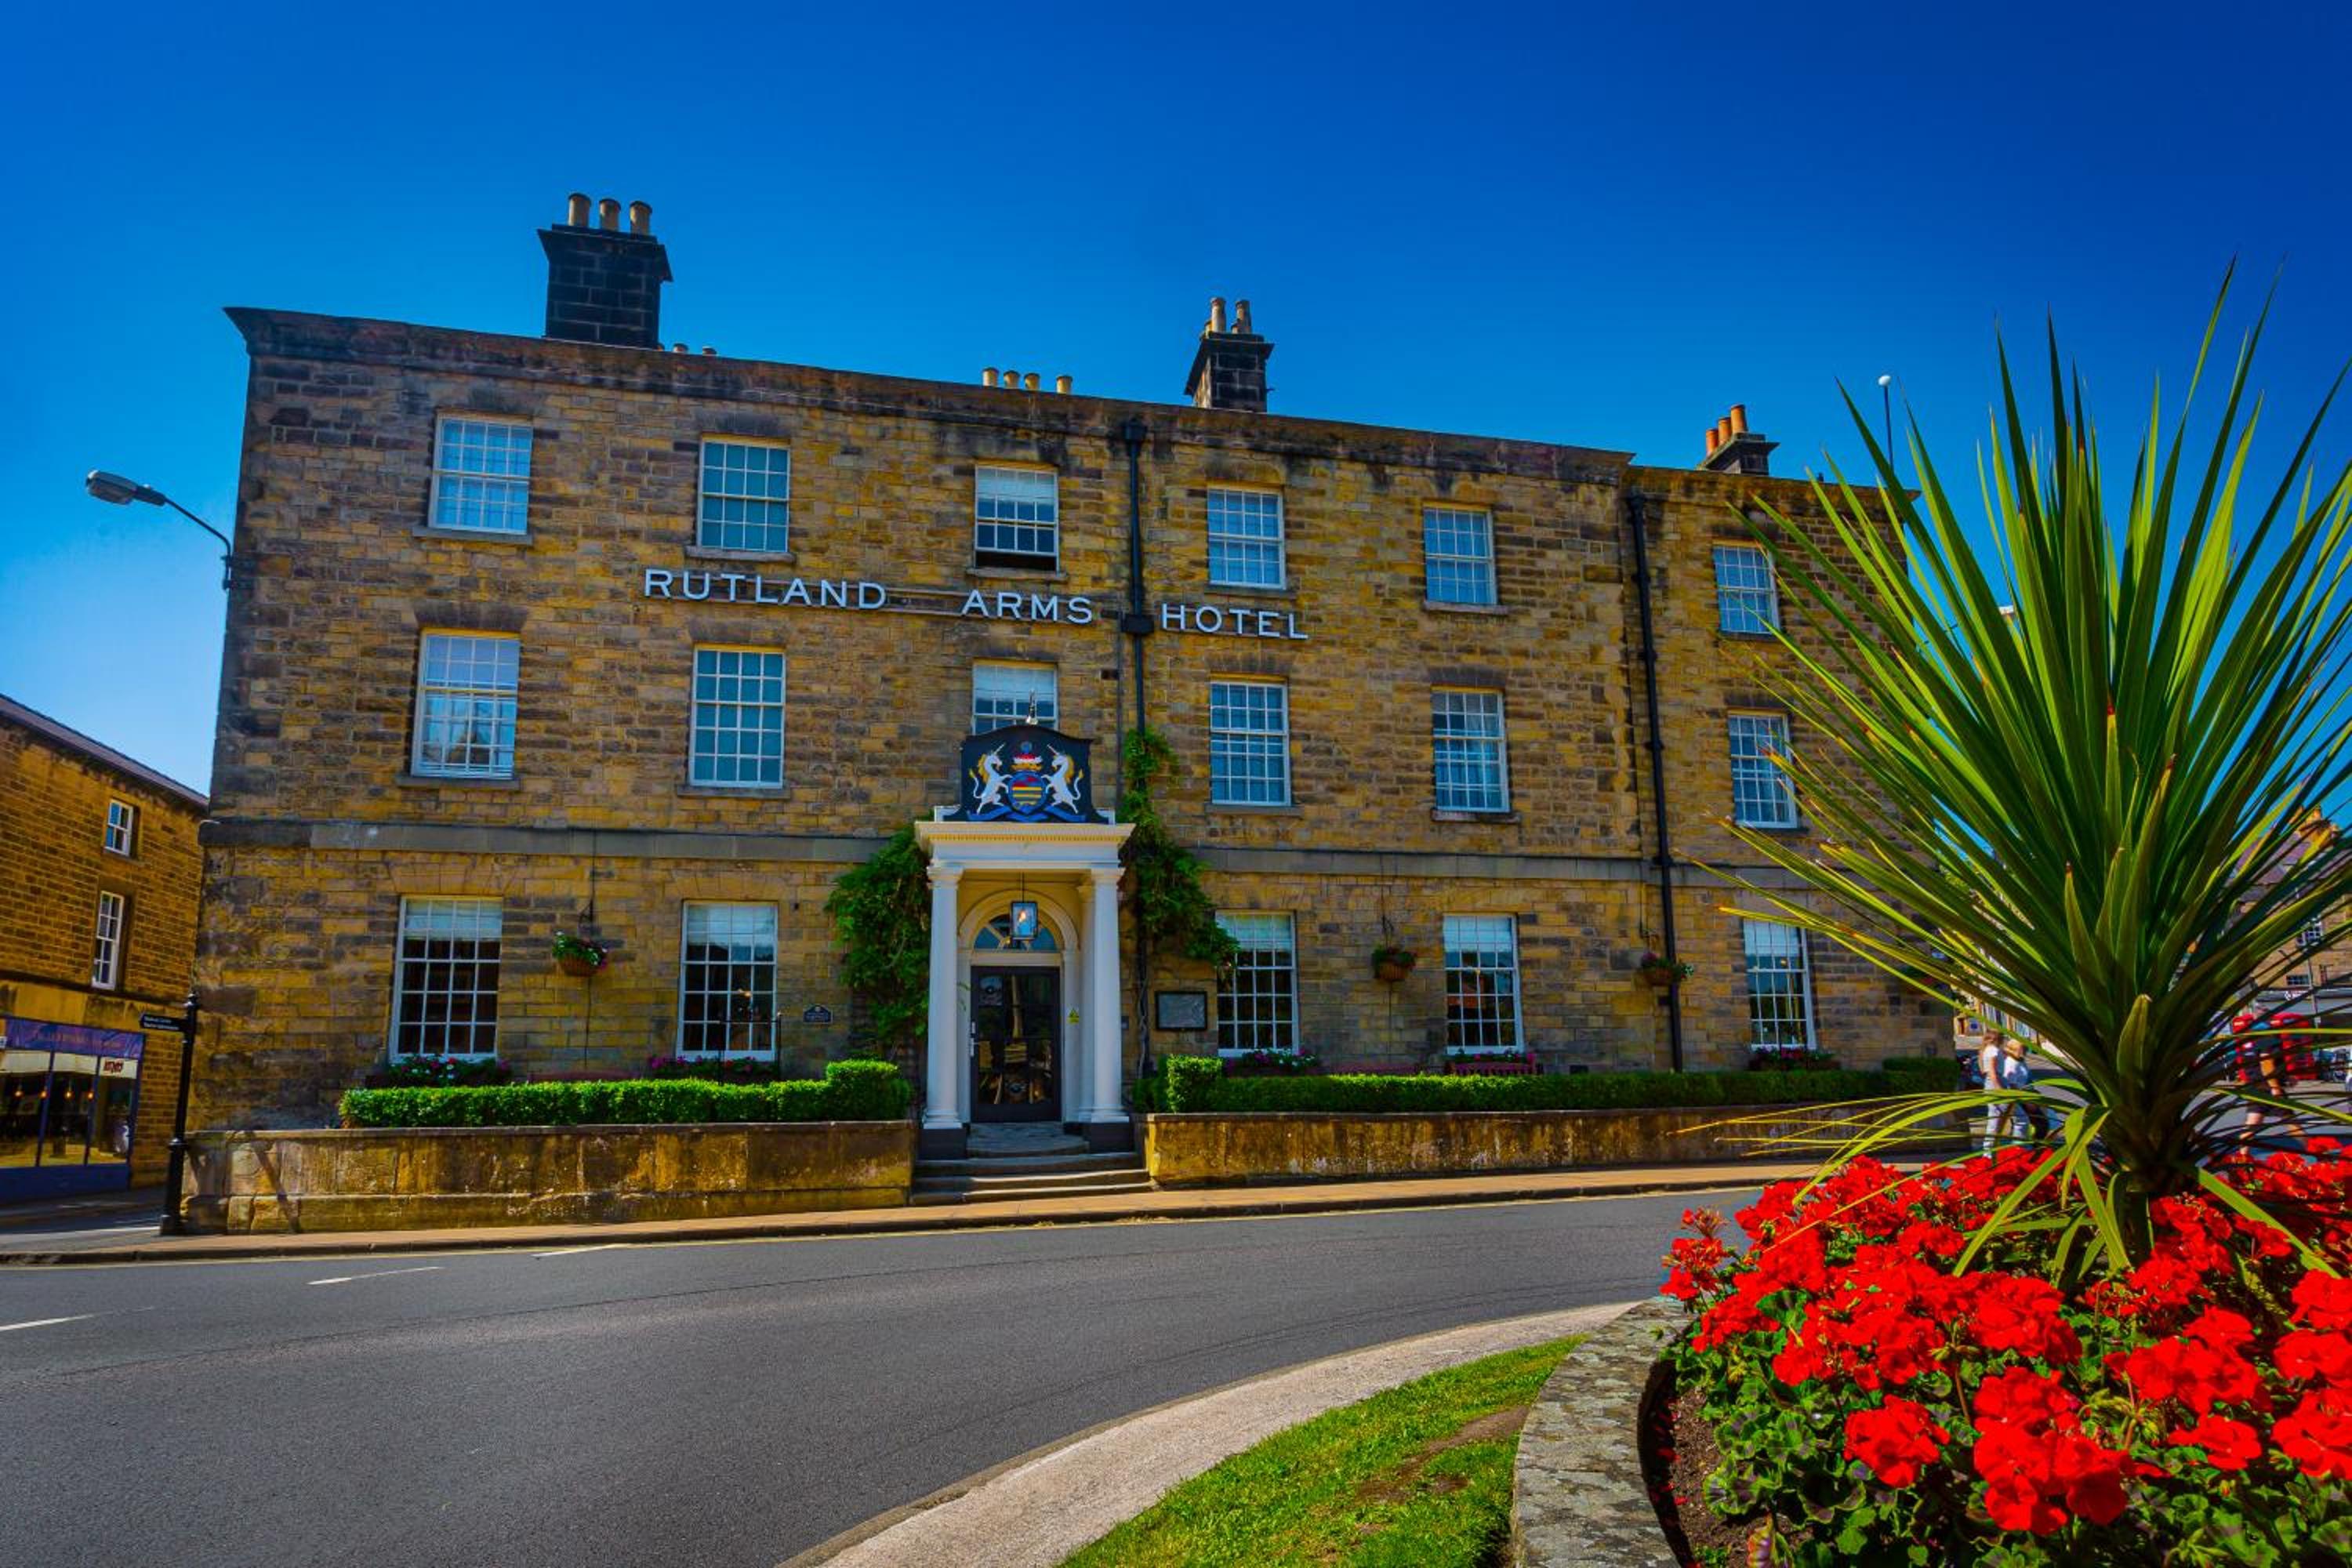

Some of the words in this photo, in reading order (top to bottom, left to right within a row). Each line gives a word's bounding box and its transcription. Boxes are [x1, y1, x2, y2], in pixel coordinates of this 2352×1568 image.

[644, 568, 887, 610] RUTLAND
[961, 589, 1094, 625] ARMS
[1161, 604, 1309, 641] HOTEL
